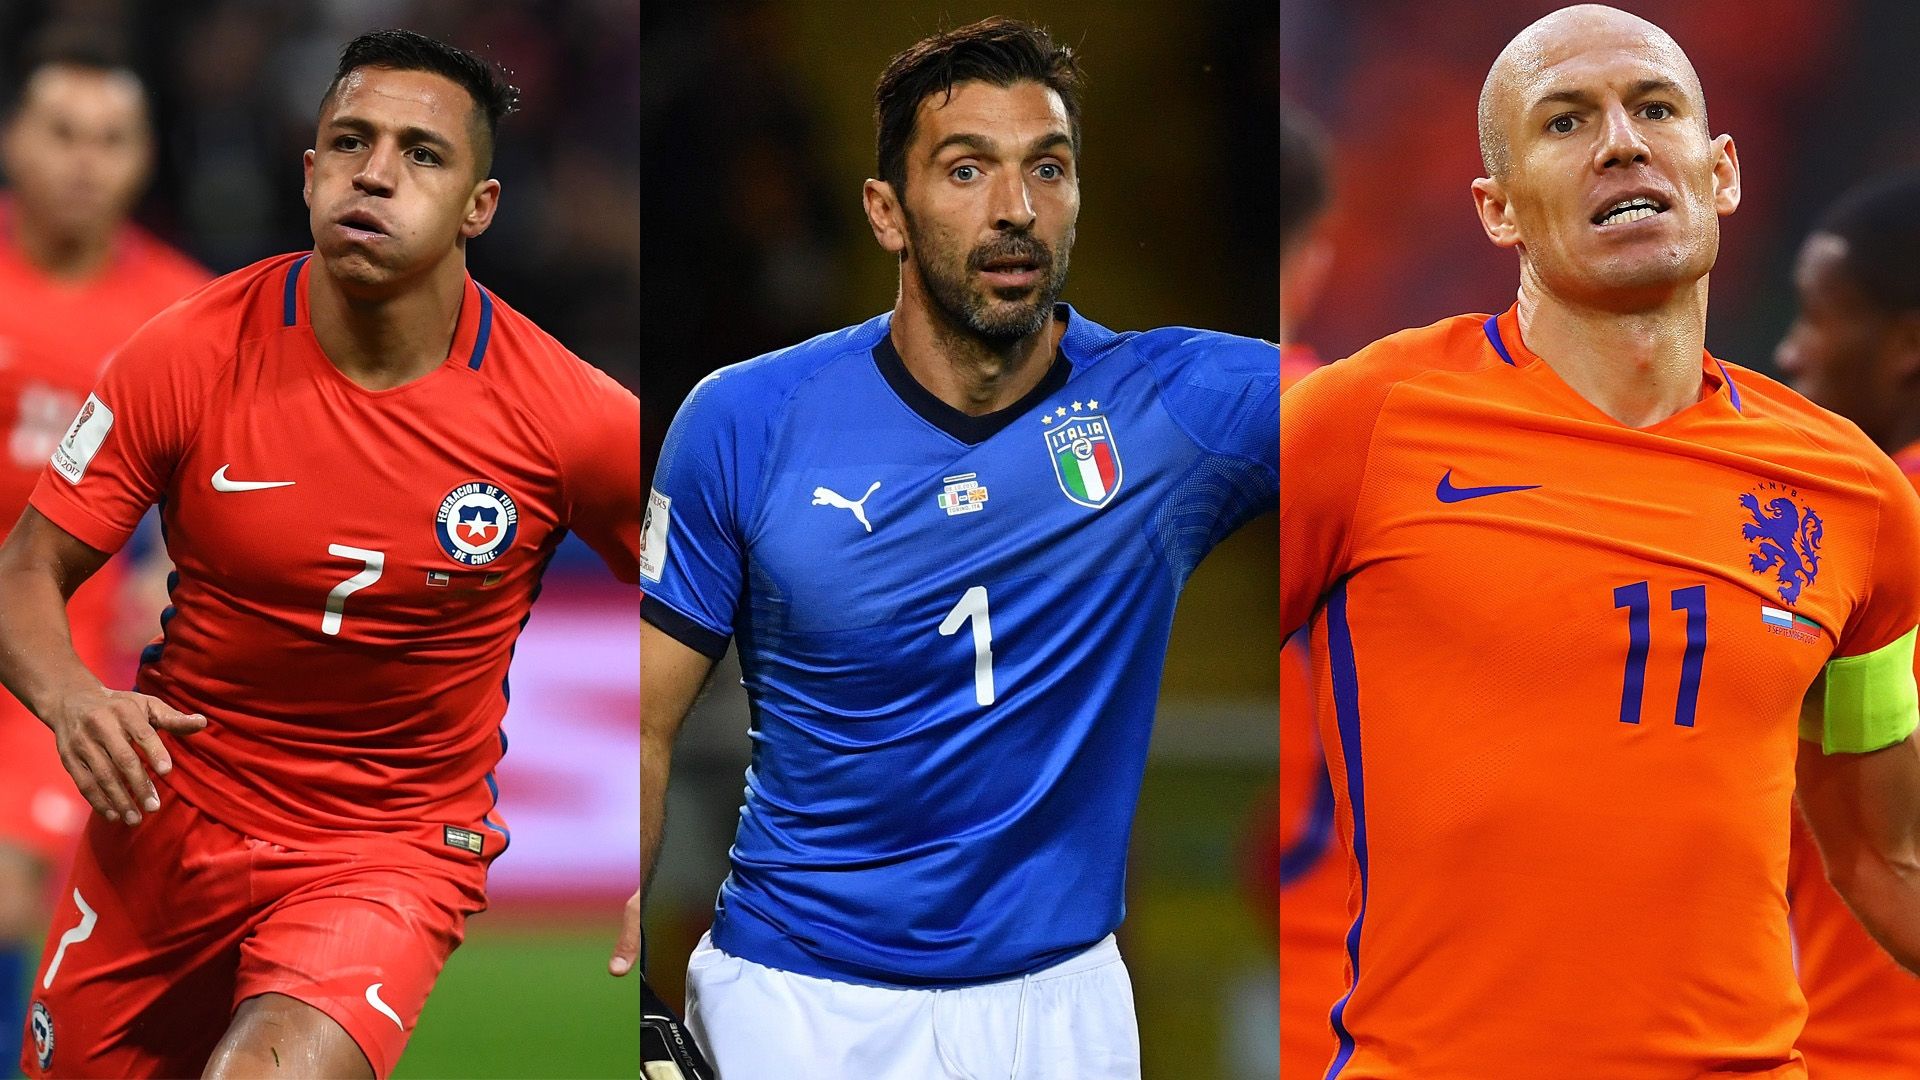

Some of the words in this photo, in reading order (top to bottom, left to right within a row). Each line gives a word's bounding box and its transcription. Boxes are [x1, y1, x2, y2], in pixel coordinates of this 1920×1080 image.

[1052, 422, 1104, 448] ITALIA
[61, 459, 81, 477] 2017
[1758, 481, 1798, 497] KNVB
[437, 483, 480, 523] FEDERACION
[485, 485, 499, 497] DE
[499, 495, 517, 526] FUTBOL
[453, 551, 467, 562] DE
[471, 551, 496, 565] CHILE
[321, 543, 385, 636] 7
[938, 585, 996, 706] 1
[1613, 581, 1707, 727] 11
[43, 887, 98, 989] 7
